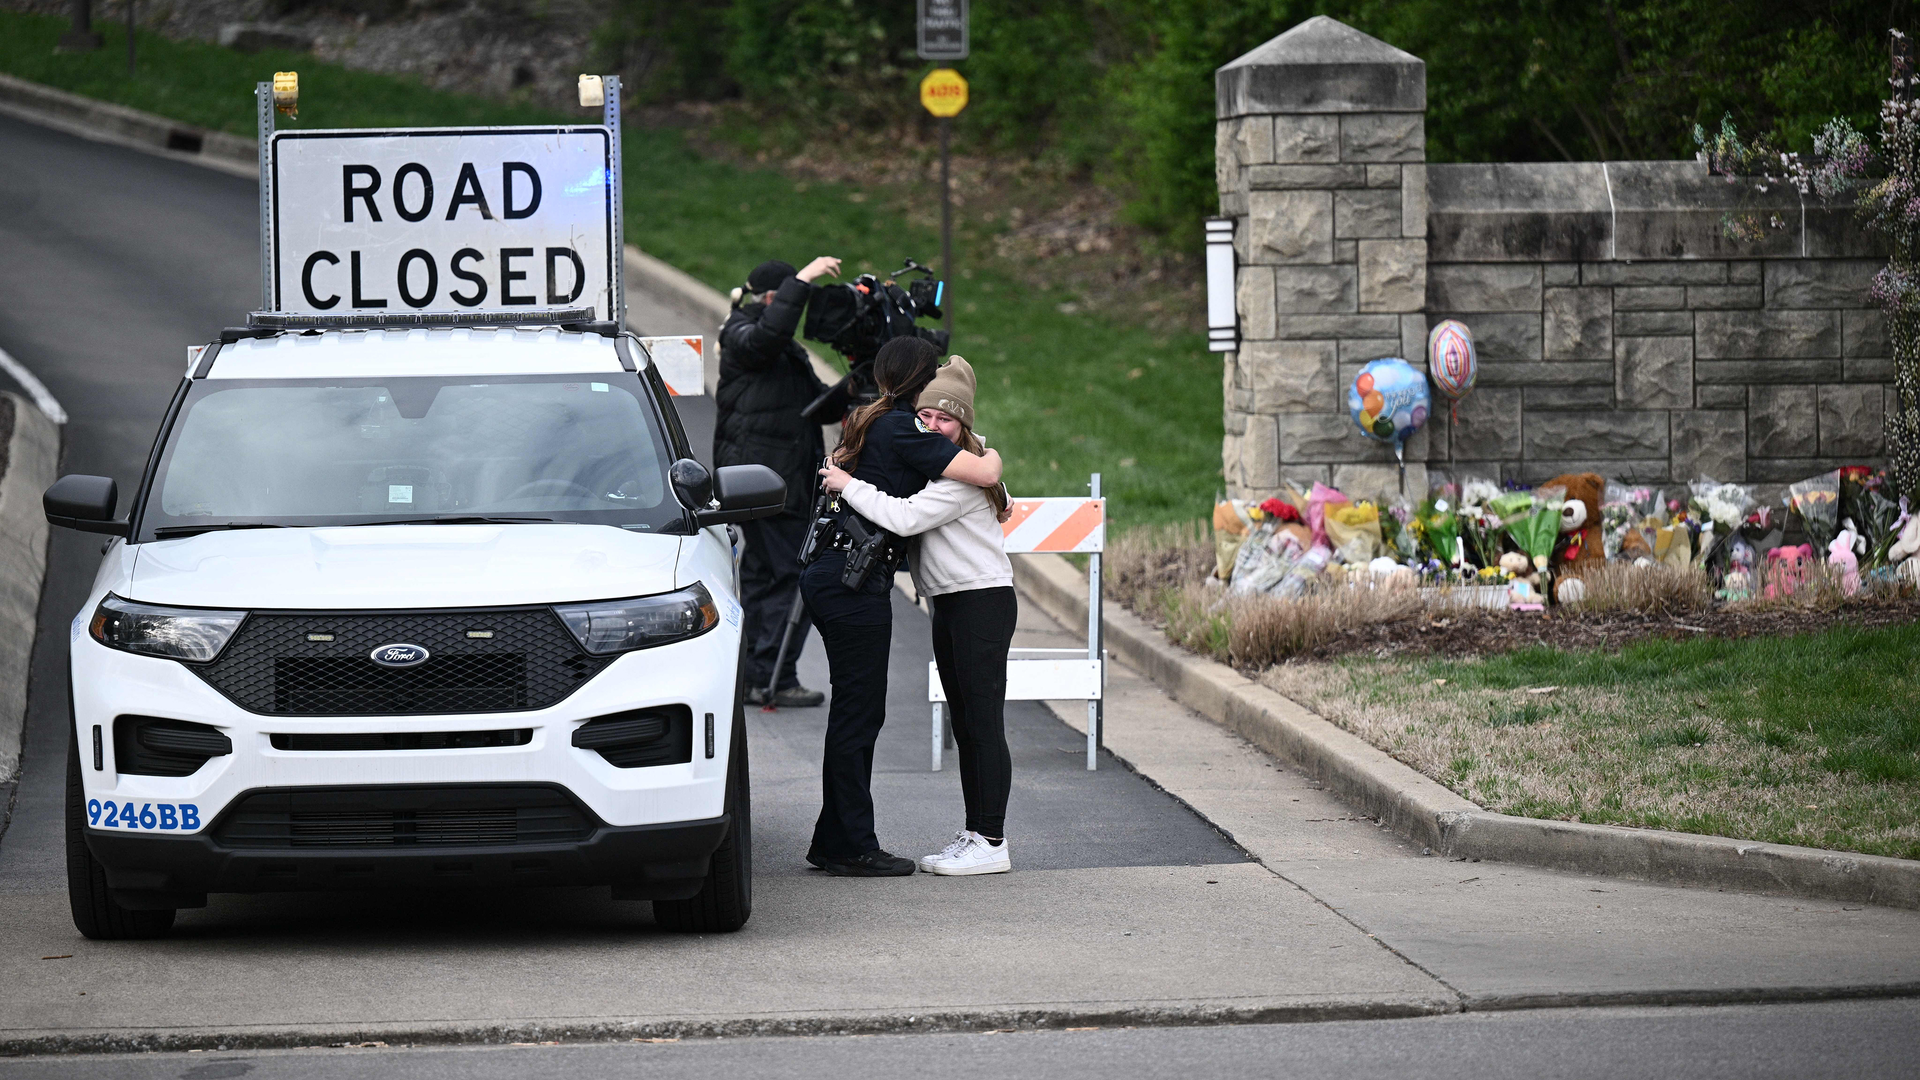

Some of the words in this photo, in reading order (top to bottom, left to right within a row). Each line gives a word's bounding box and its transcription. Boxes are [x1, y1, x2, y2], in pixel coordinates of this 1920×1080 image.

[343, 162, 542, 222] ROAD
[301, 247, 585, 310] CLOSED
[384, 648, 415, 661] Ford
[88, 799, 201, 830] 9246BB
